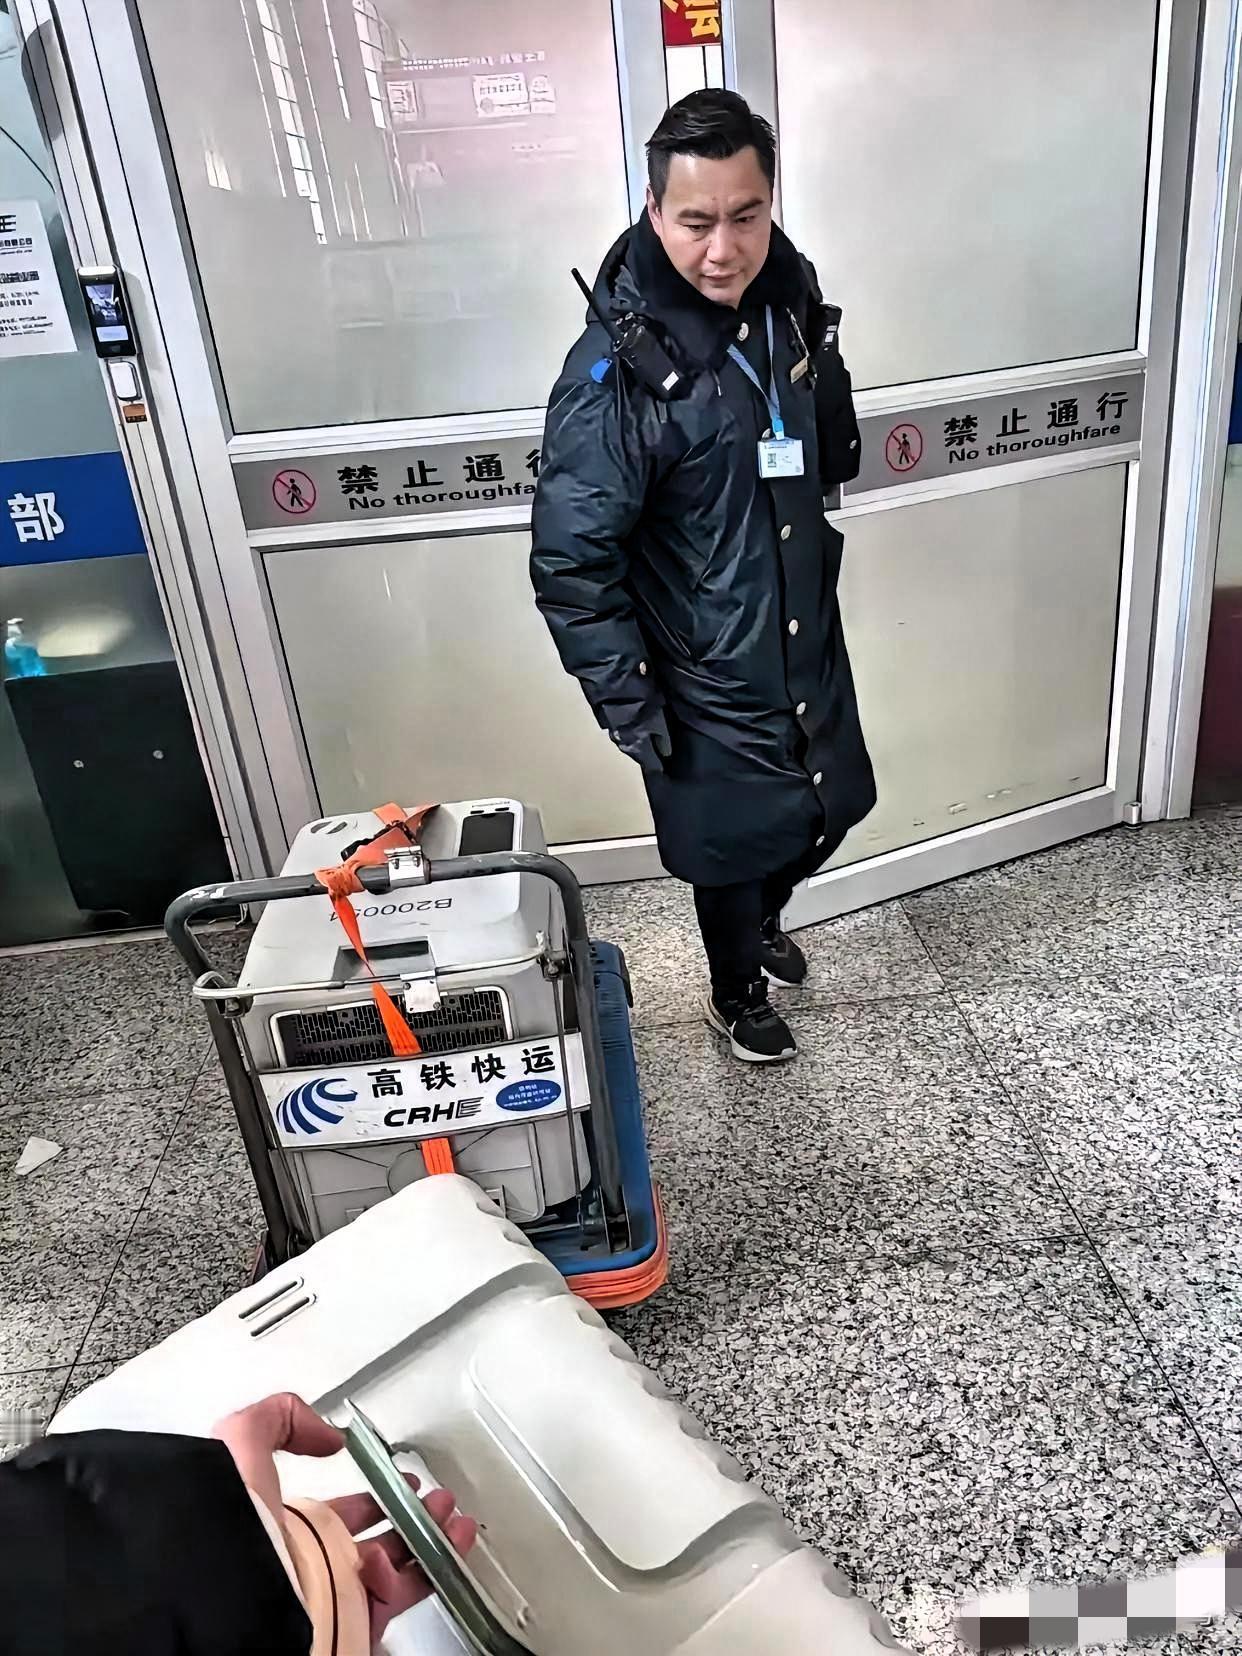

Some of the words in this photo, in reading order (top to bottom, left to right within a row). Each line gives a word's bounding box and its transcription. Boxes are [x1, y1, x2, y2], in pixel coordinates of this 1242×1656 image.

[943, 391, 1129, 448] 禁止通行
[948, 448, 980, 464] No
[986, 424, 1121, 457] thoroughfare
[7, 492, 65, 543] 部
[348, 496, 386, 511] No
[366, 1045, 556, 1099] 高铁快运
